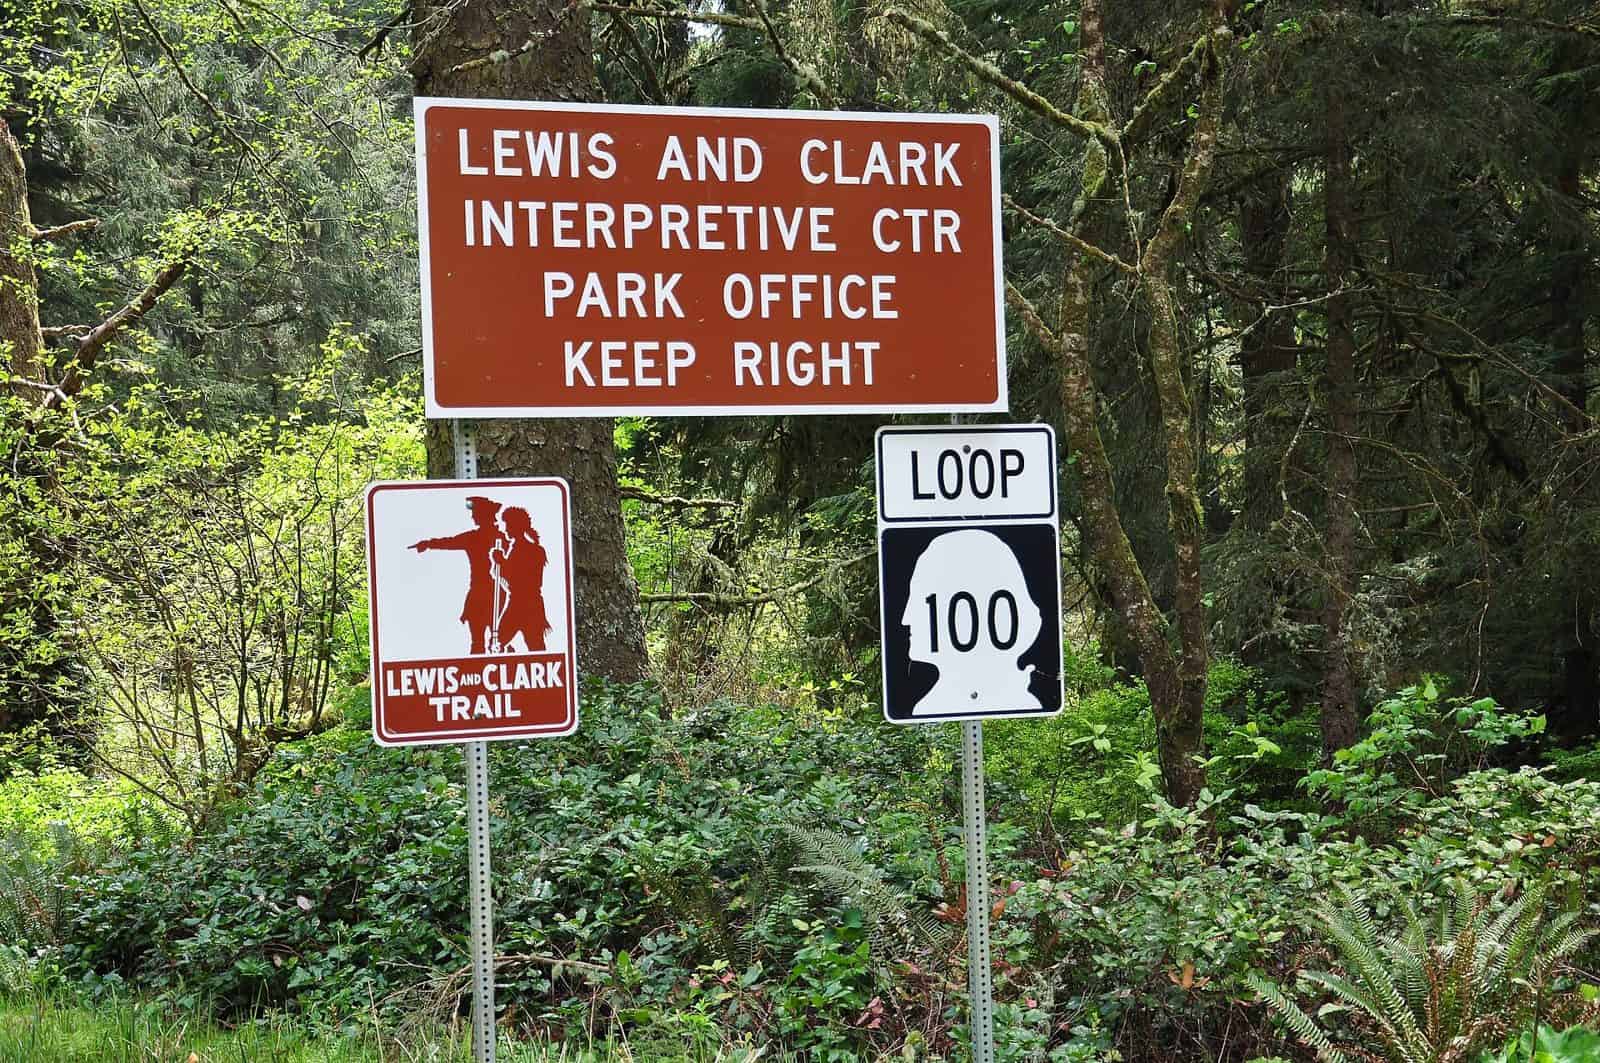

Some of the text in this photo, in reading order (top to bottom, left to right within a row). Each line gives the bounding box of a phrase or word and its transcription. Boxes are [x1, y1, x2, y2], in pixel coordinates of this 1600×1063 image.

[458, 128, 963, 187] LEWIS AND CLARK
[464, 199, 962, 253] INTERPRETIVE CTR
[543, 271, 899, 320] PARK OFFICE
[564, 341, 881, 387] KEEP RIGHT
[911, 448, 1025, 501] LOOP
[925, 590, 1019, 653] 100
[386, 661, 564, 697] LEWIS AND CLARK
[428, 693, 522, 722] TRAIL
